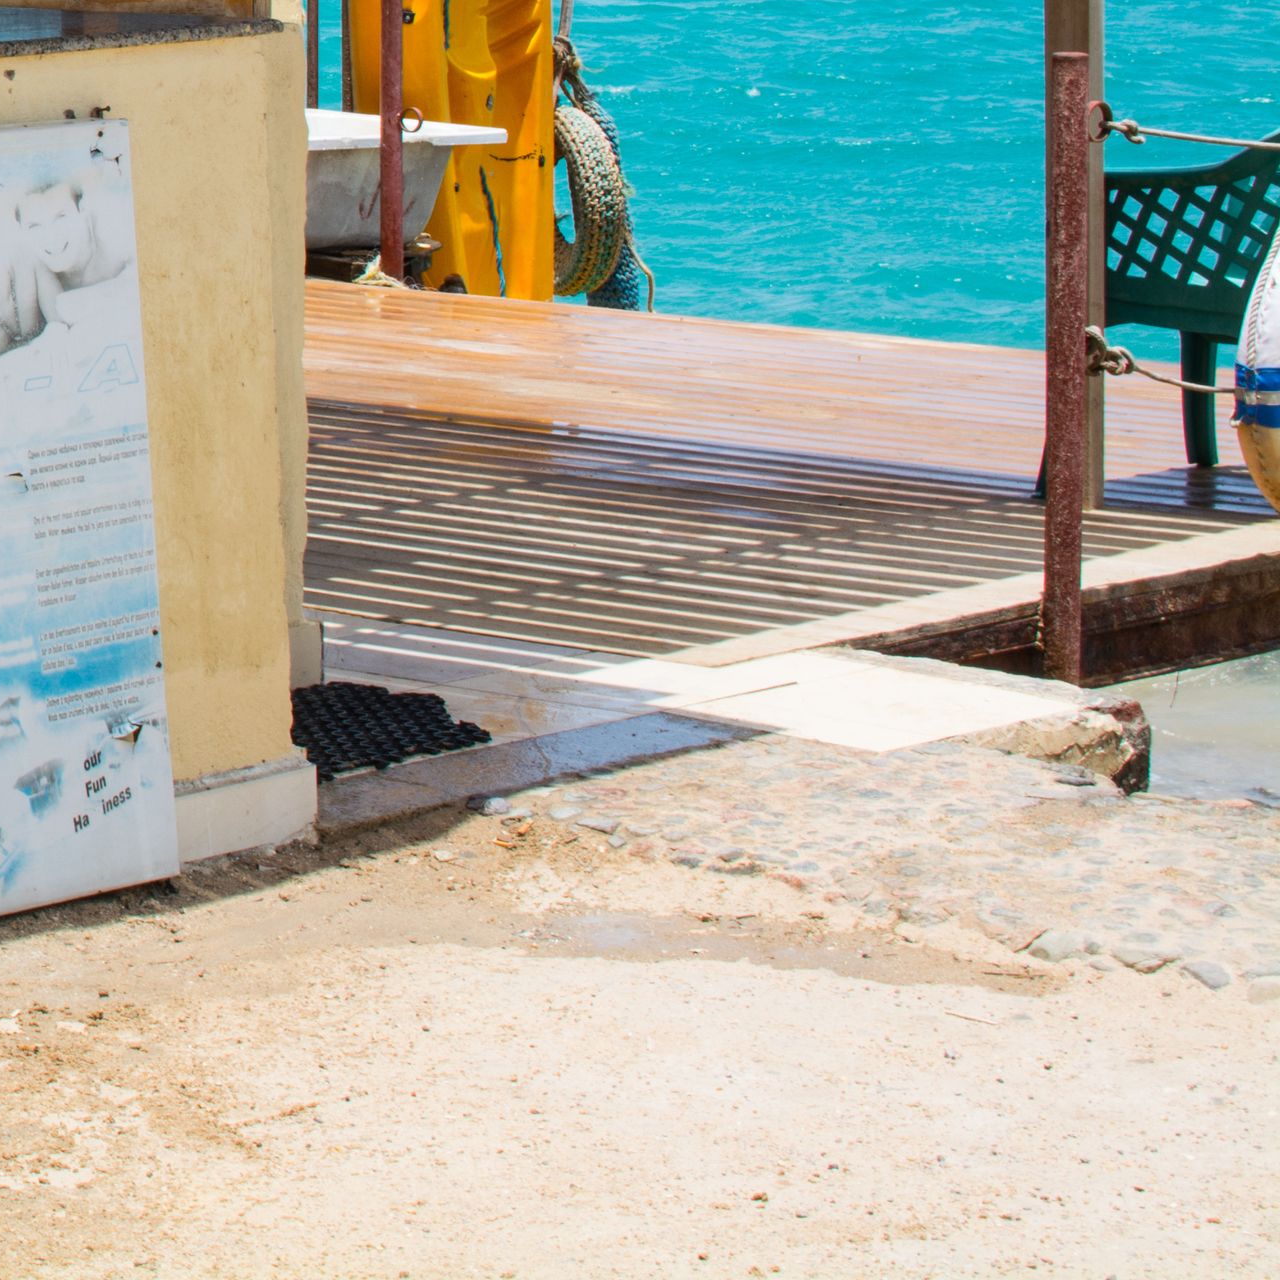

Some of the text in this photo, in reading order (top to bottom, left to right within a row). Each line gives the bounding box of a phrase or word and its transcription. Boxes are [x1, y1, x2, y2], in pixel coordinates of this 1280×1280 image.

[77, 343, 140, 393] A
[83, 750, 102, 772] our
[85, 775, 107, 798] Fun
